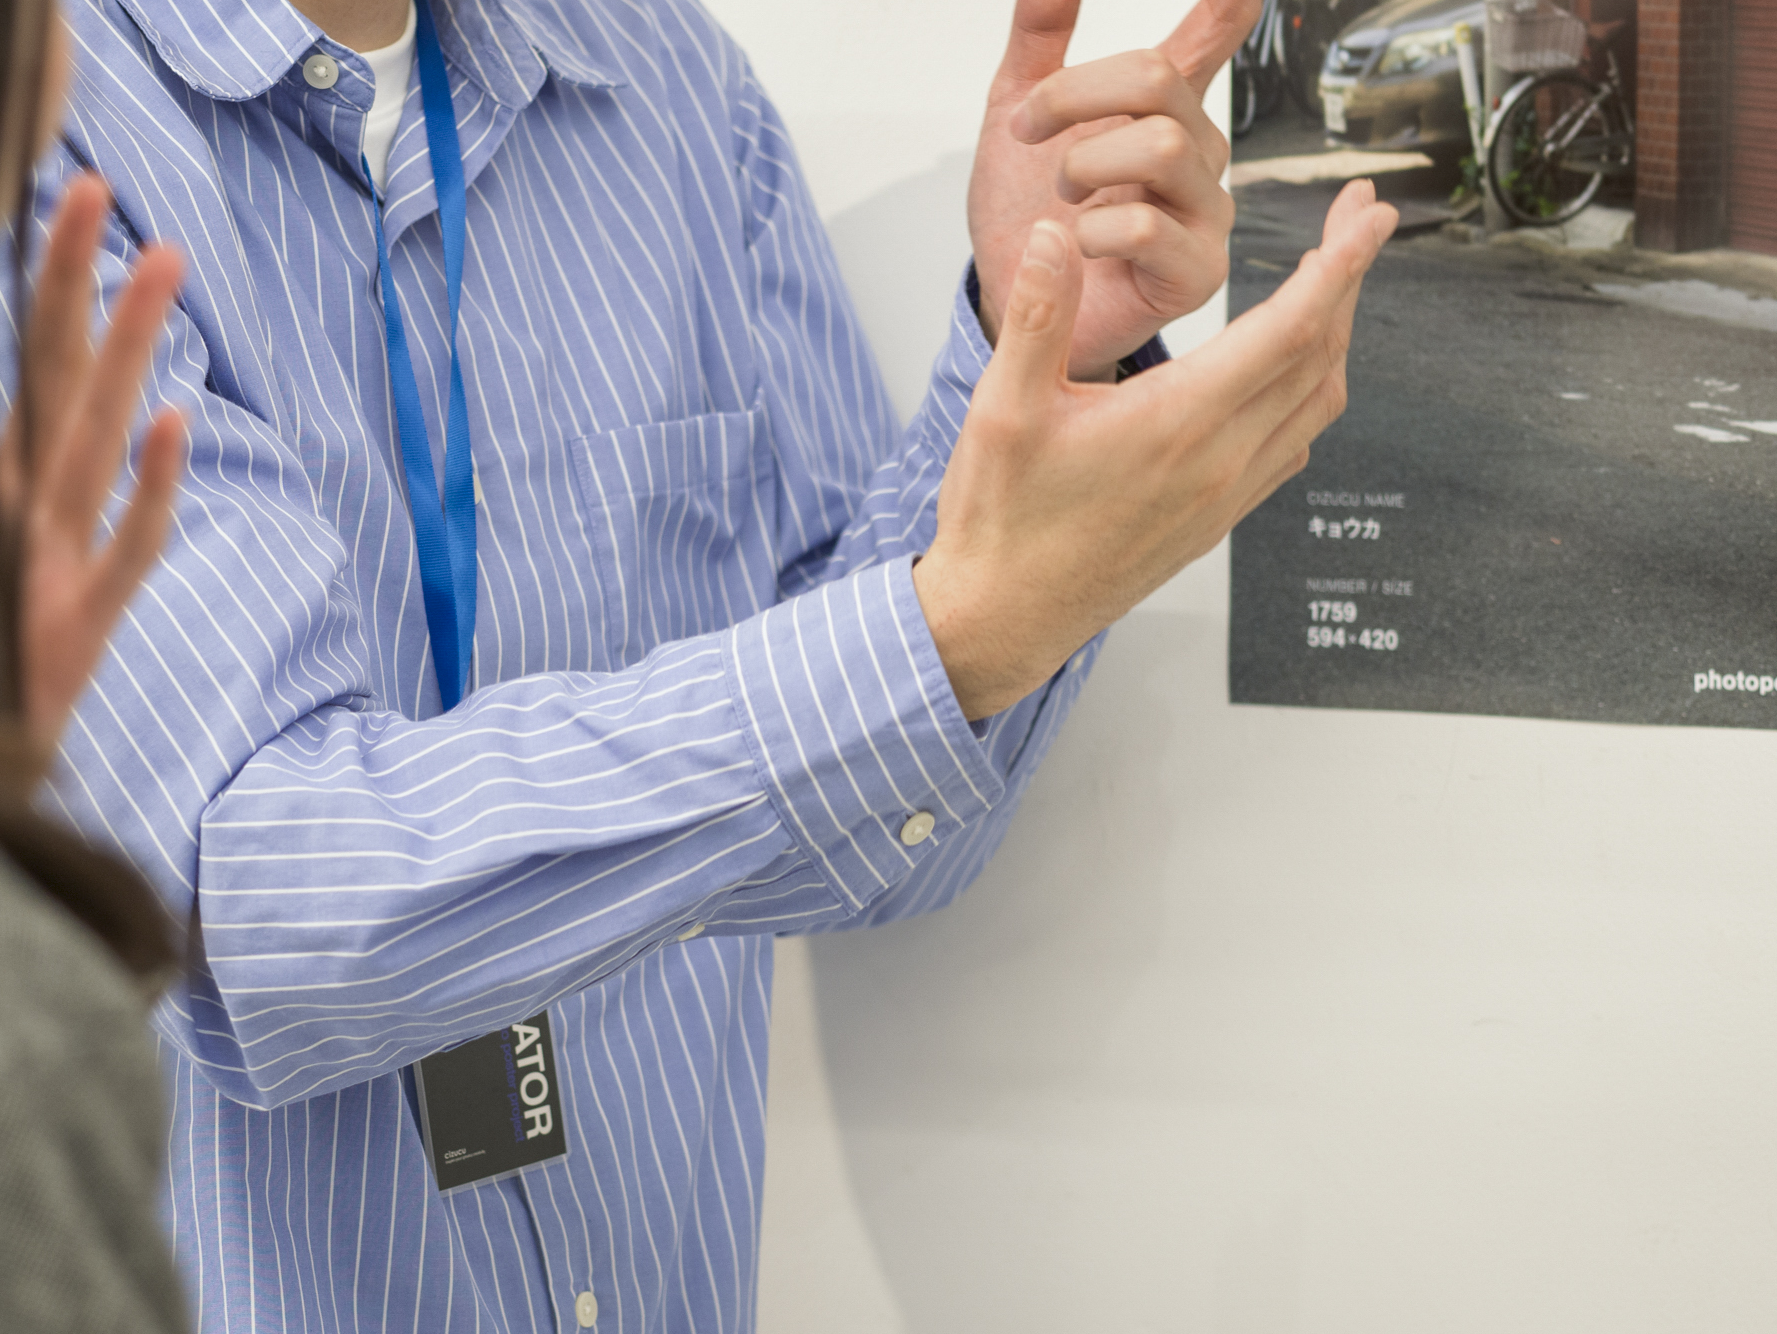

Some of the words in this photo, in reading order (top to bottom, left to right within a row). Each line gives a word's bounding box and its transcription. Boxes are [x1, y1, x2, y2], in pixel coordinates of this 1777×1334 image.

[1306, 490, 1361, 507] CIZUCU
[1364, 493, 1406, 508] NAME
[1308, 515, 1381, 540] キョウカ
[1306, 578, 1368, 594] NUMBER
[1382, 580, 1414, 596] SIZE
[1307, 600, 1358, 623] 1759
[501, 1043, 517, 1089] poster
[507, 1092, 526, 1143] project
